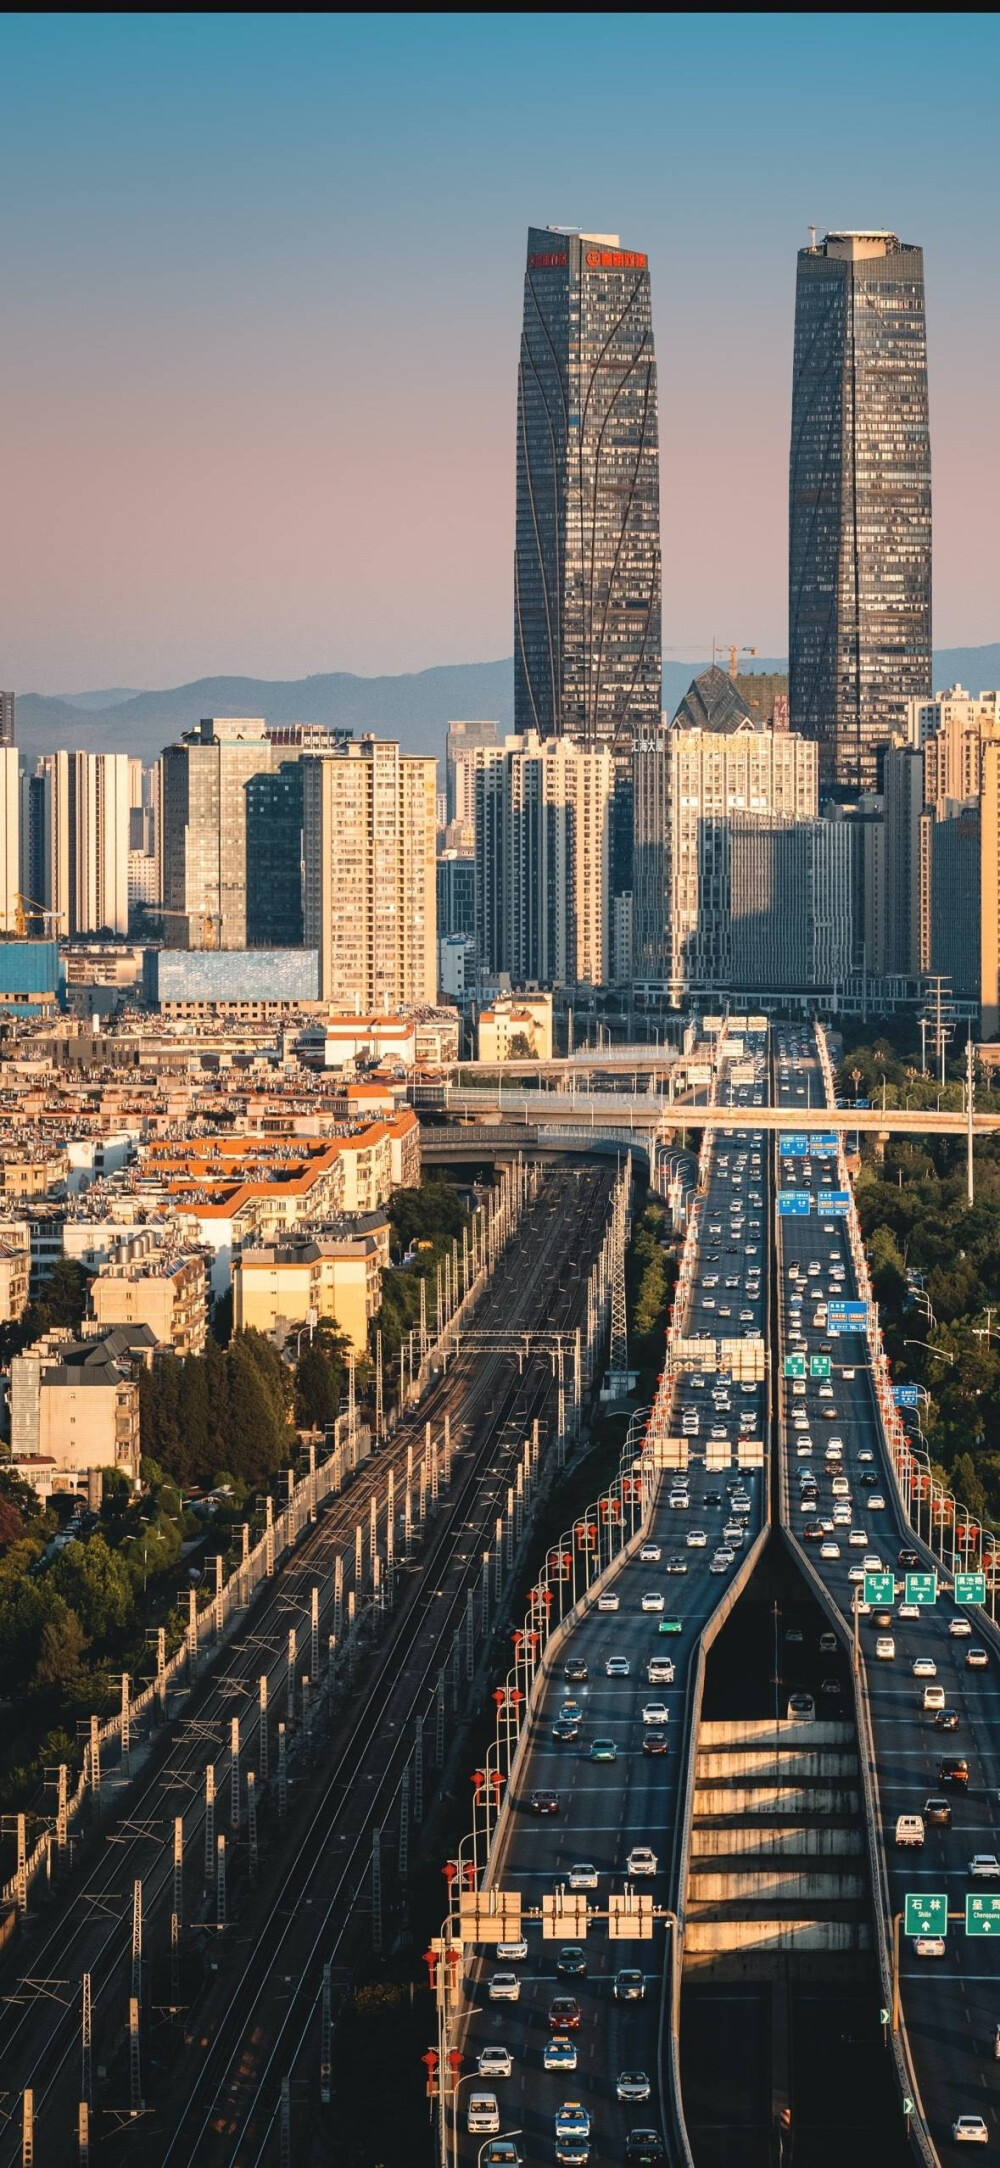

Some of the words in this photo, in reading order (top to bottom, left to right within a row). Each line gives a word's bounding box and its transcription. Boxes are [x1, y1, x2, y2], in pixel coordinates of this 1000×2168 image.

[631, 738, 664, 753] 汇海大厦
[868, 1577, 890, 1586] 石林
[910, 1576, 931, 1586] 呈贡
[911, 1899, 941, 1910] 石林
[972, 1899, 1000, 1910] 呈贡
